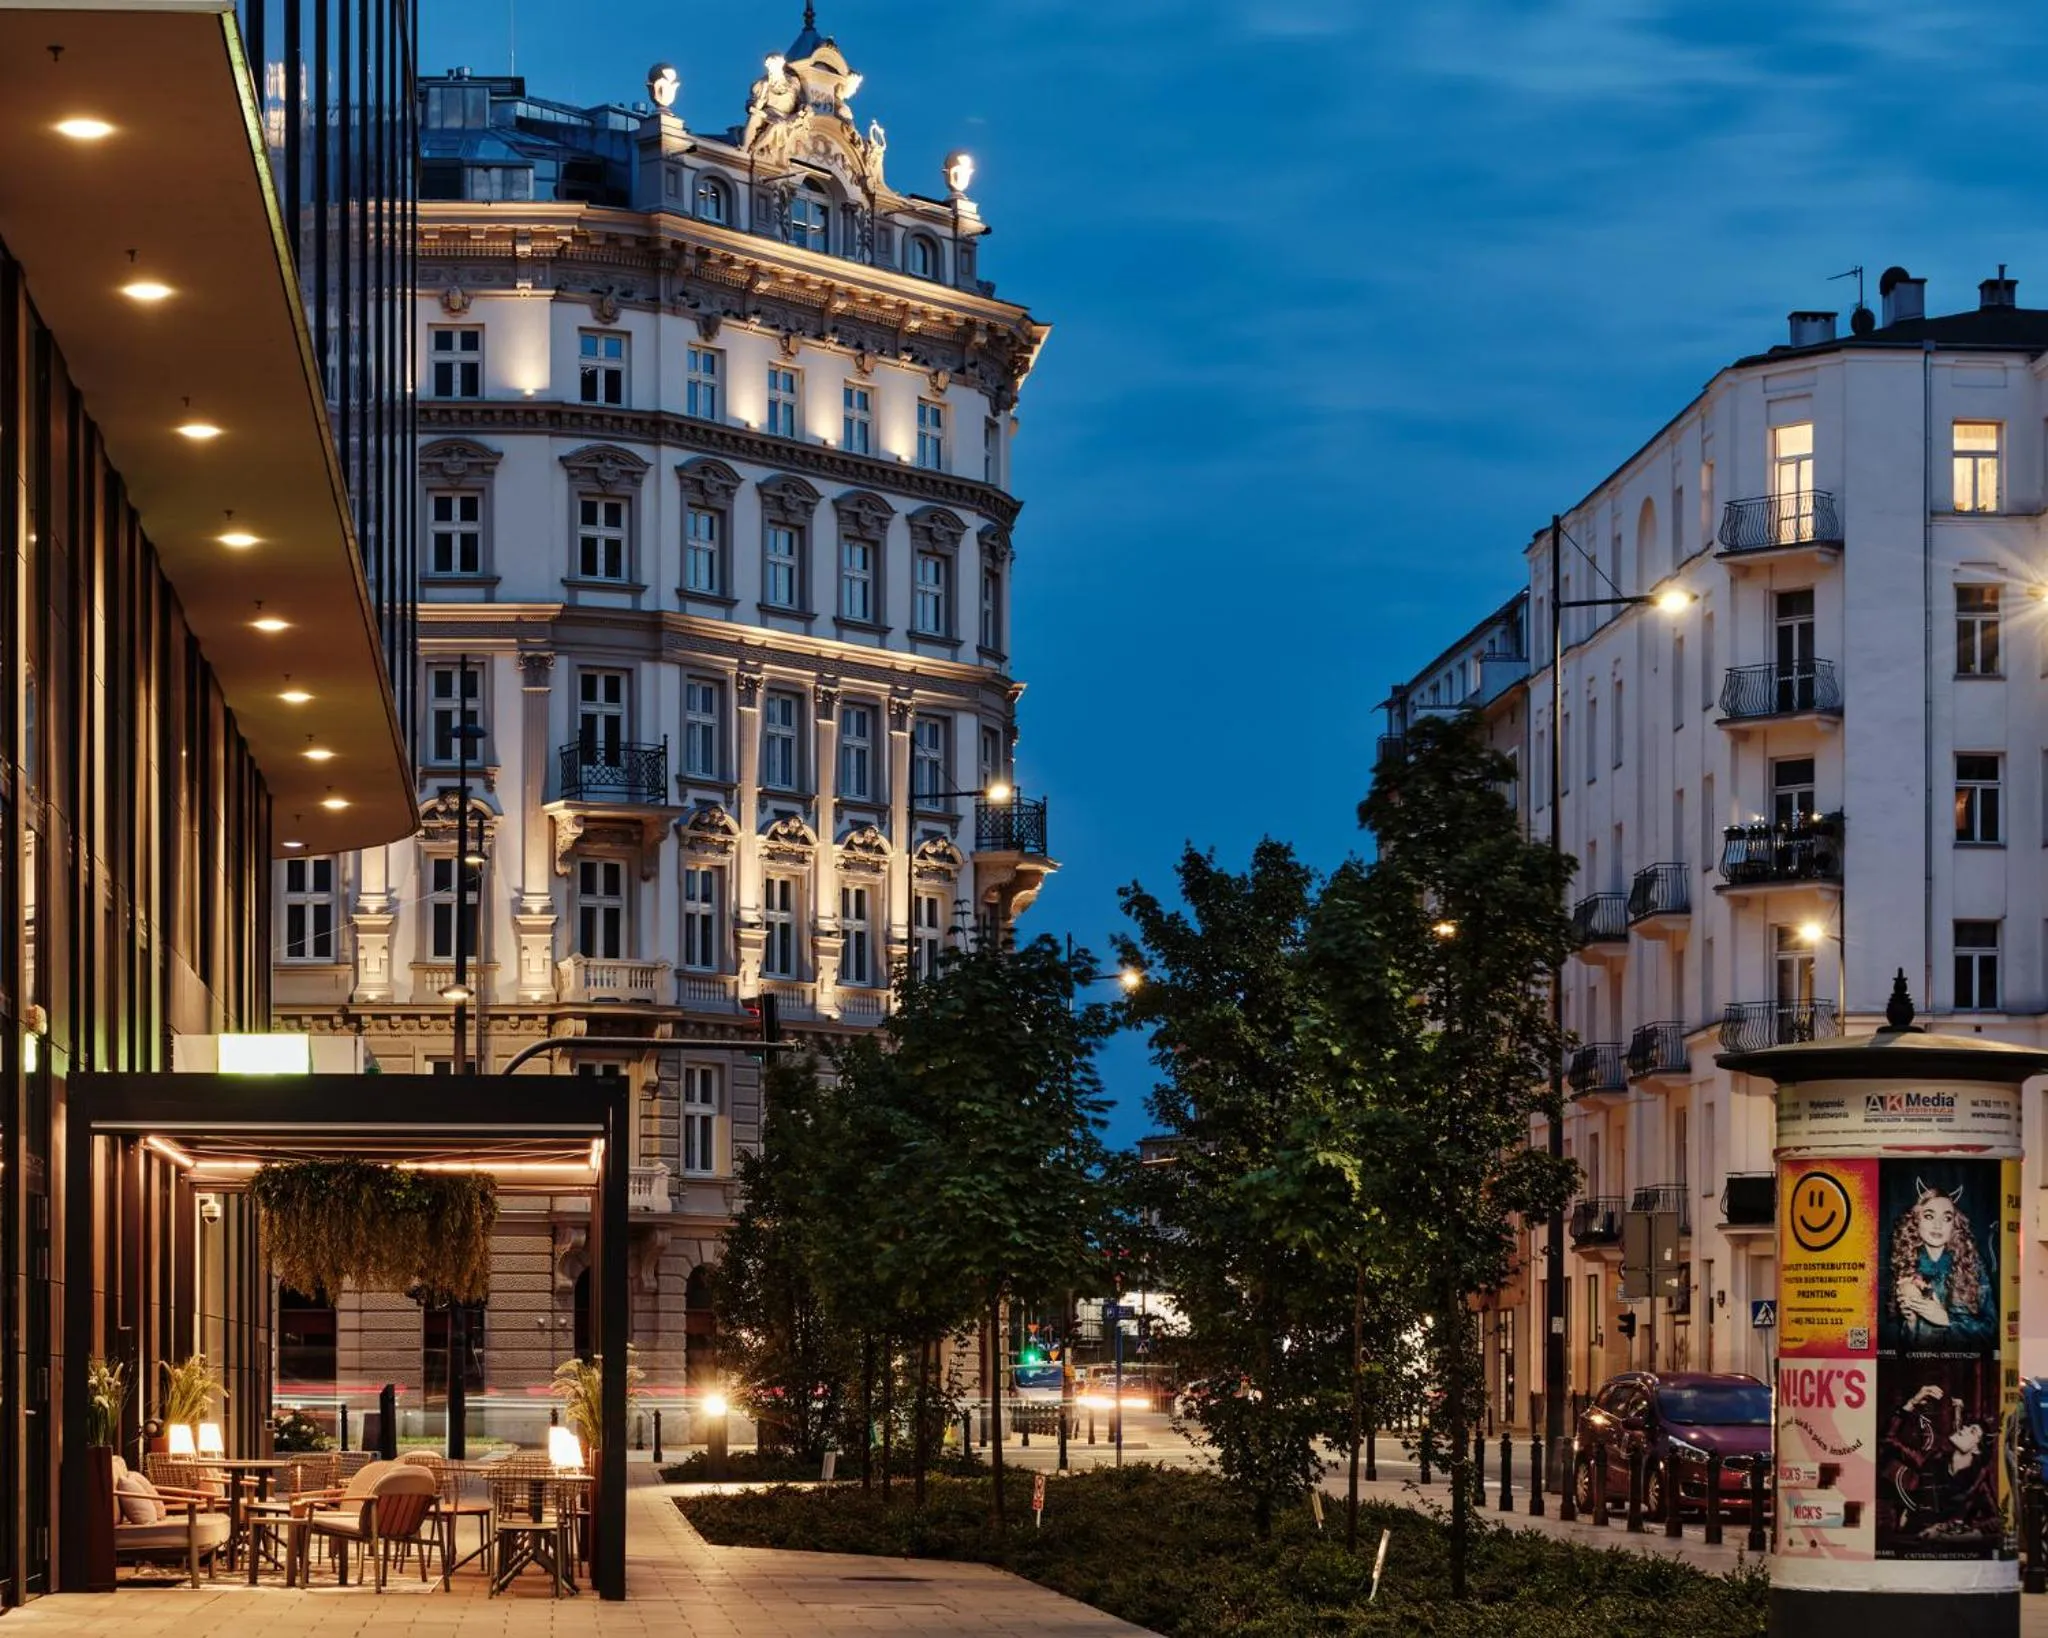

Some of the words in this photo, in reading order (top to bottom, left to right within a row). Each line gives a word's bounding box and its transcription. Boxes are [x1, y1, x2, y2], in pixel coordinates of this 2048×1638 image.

[1905, 1092, 1955, 1107] Media
[1804, 1262, 1866, 1271] DISTRIBUTION
[1804, 1276, 1859, 1284] DISTRIBUTION
[1797, 1289, 1837, 1299] PRINTING
